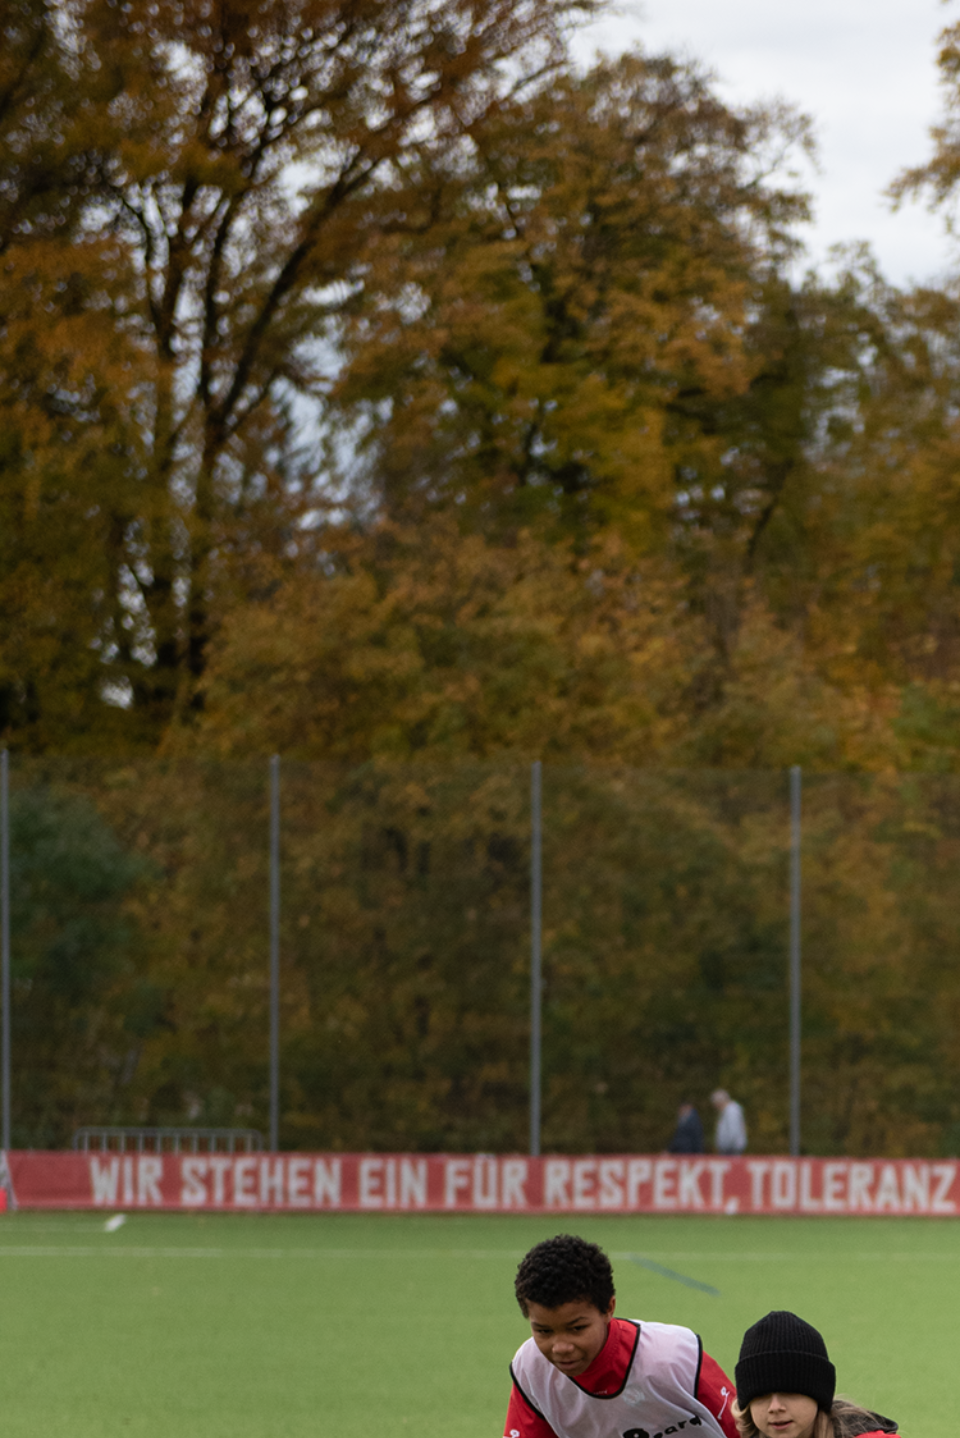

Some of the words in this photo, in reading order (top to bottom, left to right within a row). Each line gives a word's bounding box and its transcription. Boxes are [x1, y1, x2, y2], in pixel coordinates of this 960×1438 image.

[90, 1156, 163, 1206] WIR
[181, 1157, 342, 1209] STEHEN
[358, 1157, 430, 1209] EIN
[545, 1158, 739, 1215] RESPEKT,
[747, 1160, 957, 1213] TOLERANZ
